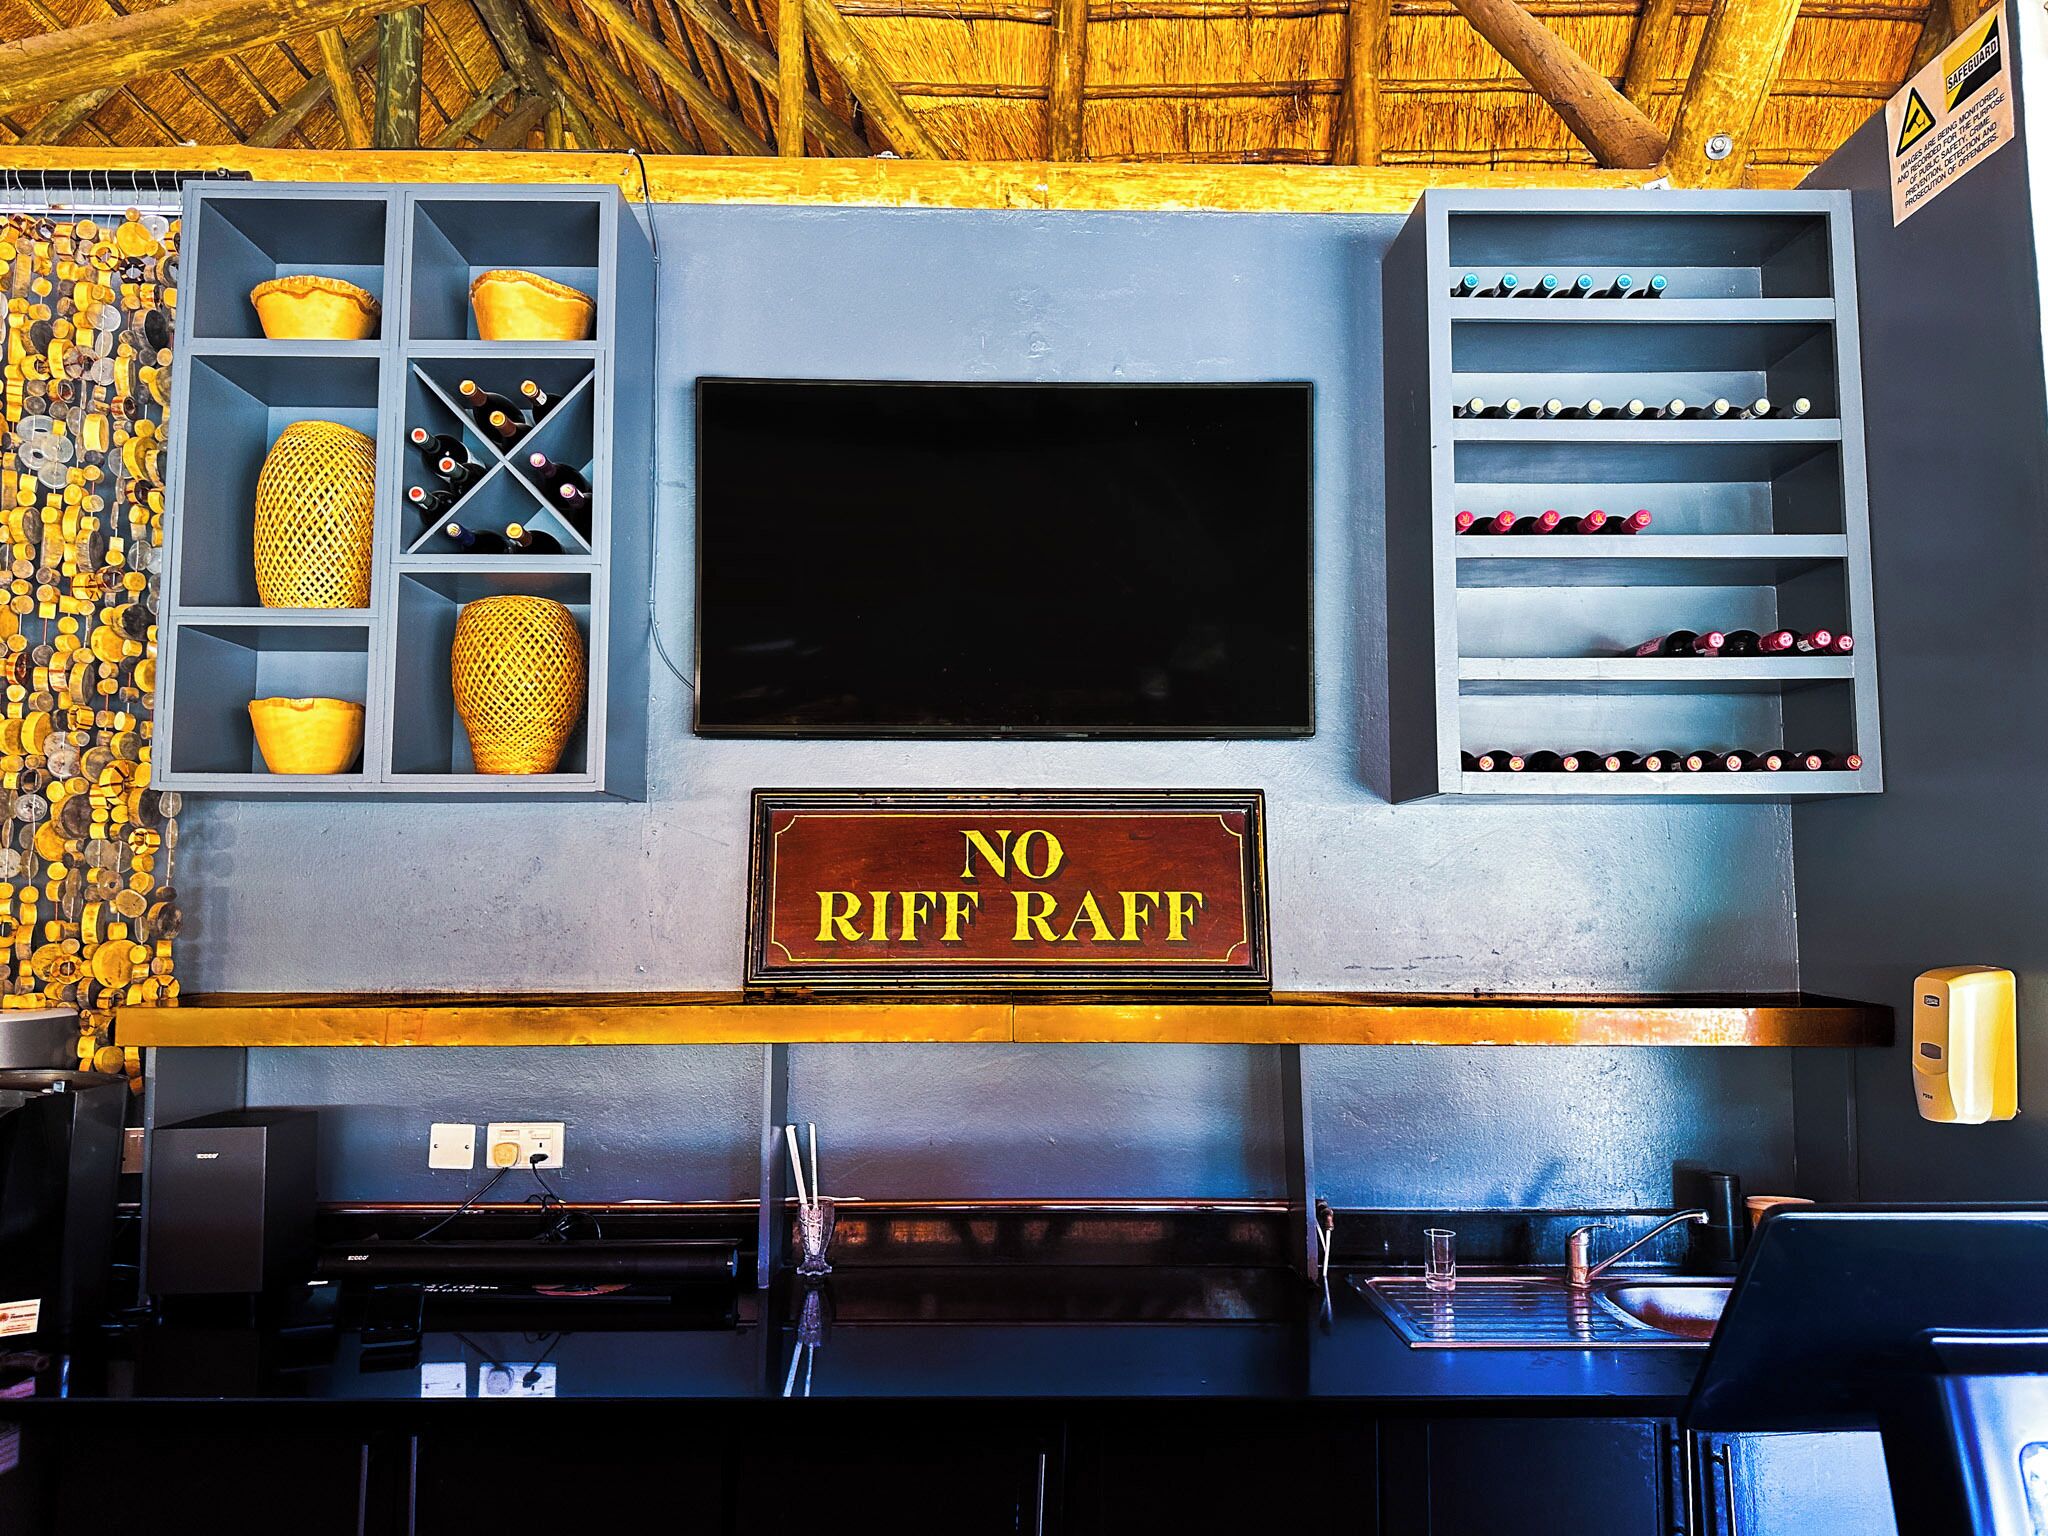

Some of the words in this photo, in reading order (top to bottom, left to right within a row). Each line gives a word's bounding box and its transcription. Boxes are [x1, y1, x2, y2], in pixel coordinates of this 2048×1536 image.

[1946, 39, 1998, 90] SAFEGUARD
[1897, 170, 1910, 185] AND
[1910, 143, 1942, 174] RECORDED
[1943, 132, 1957, 147] FOR
[1959, 120, 1972, 135] THE
[1973, 92, 2006, 124] PURPOSE
[1901, 148, 1923, 171] IMAGES
[1924, 136, 1937, 151] ARE
[1938, 120, 1958, 141] BEING
[1959, 87, 1999, 125] MONITORED
[1909, 173, 1918, 185] OF
[1919, 155, 1940, 177] PUBLIC
[1969, 114, 1991, 137] CRIME
[1944, 133, 1981, 168] DETECTION
[1982, 121, 1997, 138] AND
[1904, 171, 1947, 209] PROSECUTION
[1947, 162, 1957, 176] OF
[959, 829, 1065, 880] NO
[814, 890, 979, 942] RIFF
[1010, 890, 1204, 942] RAFF
